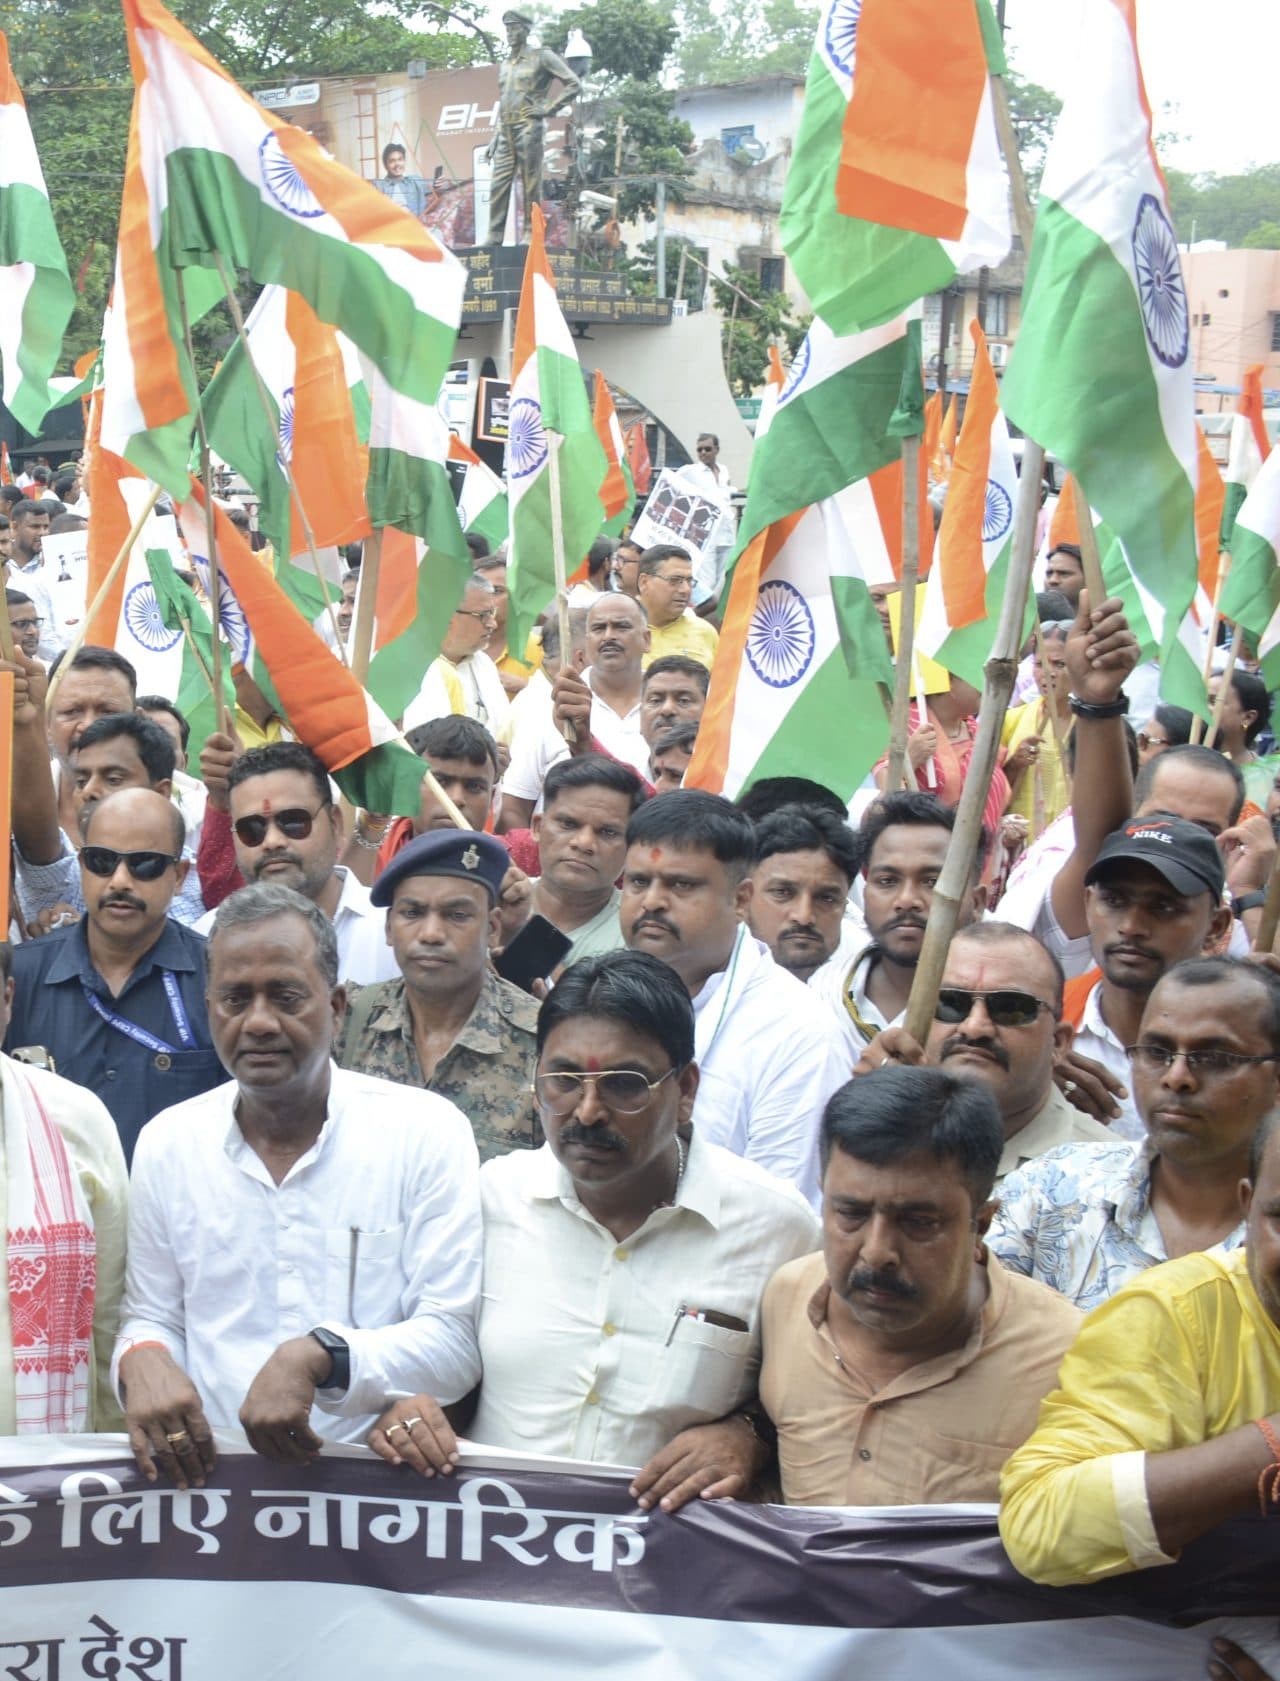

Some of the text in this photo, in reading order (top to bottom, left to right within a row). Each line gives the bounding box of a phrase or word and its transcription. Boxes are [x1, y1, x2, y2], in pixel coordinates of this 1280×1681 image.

[1131, 830, 1174, 845] NIKE
[56, 1472, 231, 1554] लिए
[251, 1478, 650, 1573] नागरिक
